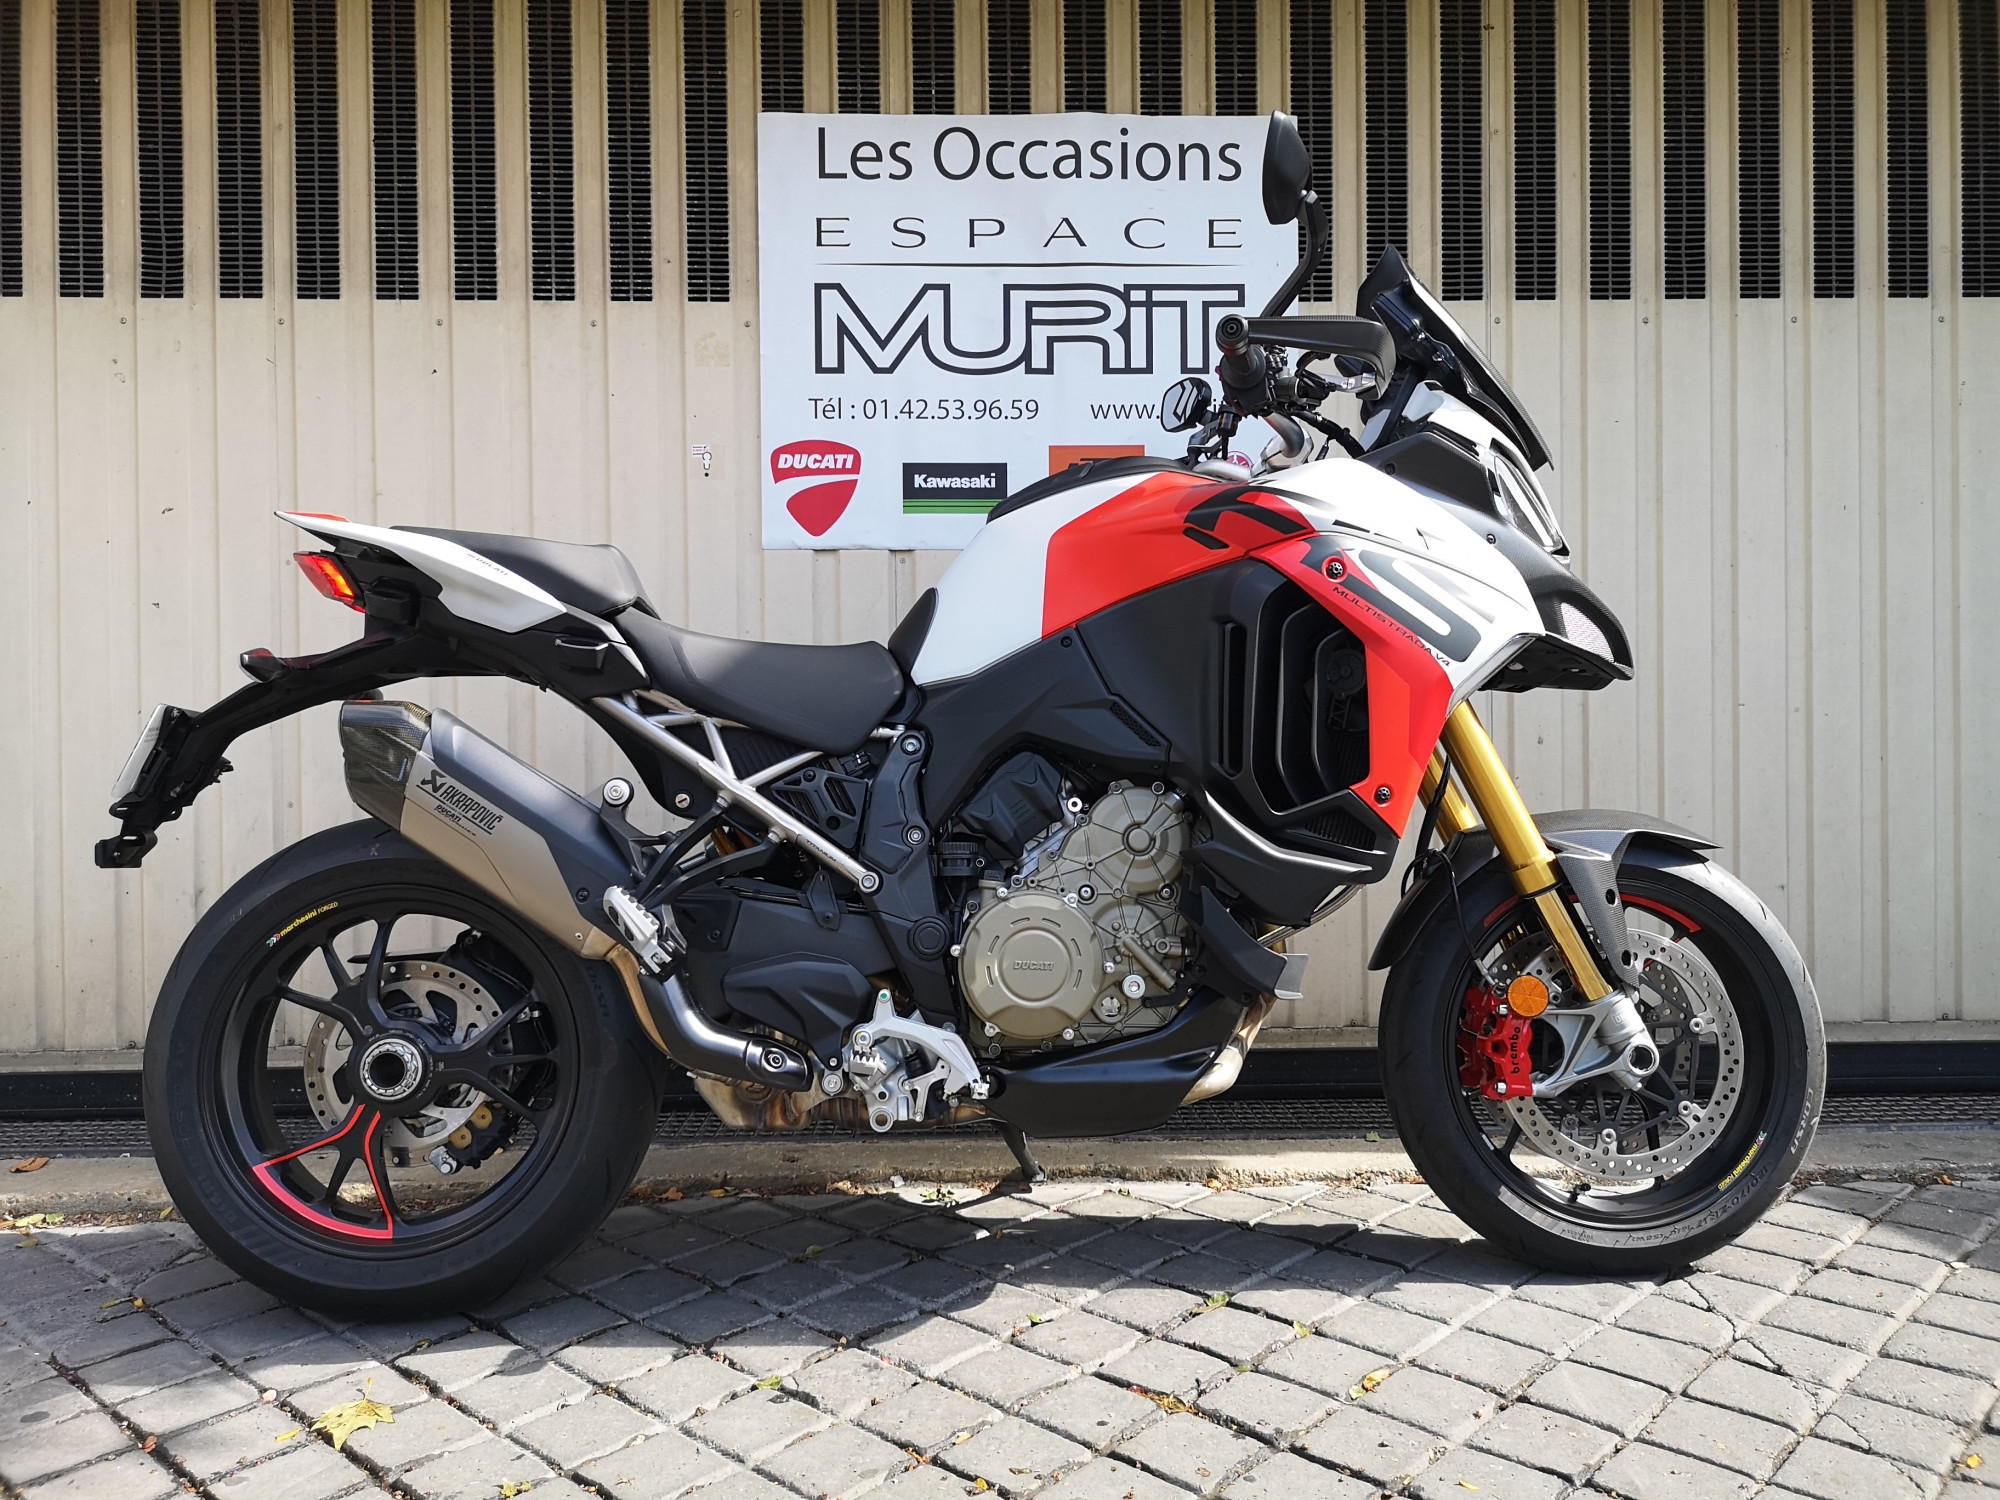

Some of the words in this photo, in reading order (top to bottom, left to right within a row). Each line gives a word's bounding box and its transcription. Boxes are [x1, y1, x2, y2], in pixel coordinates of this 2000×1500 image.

[818, 127, 912, 180] Les
[934, 127, 1241, 181] Occasions
[816, 217, 1242, 249] ESPACE
[808, 398, 841, 419] Tél
[864, 399, 1038, 419] 01.42.53.96.59
[778, 454, 854, 468] DUCATI
[915, 473, 995, 488] Kawasaki
[1333, 587, 1432, 655] MULTISTRADA
[1435, 652, 1451, 667] V4
[435, 804, 462, 823] DUCATI
[280, 909, 317, 936] marchesini
[1013, 960, 1055, 971] DUCATI
[1510, 1026, 1521, 1074] brembo
[1790, 1087, 1814, 1154] CORSA
[1732, 1143, 1759, 1177] marchesini
